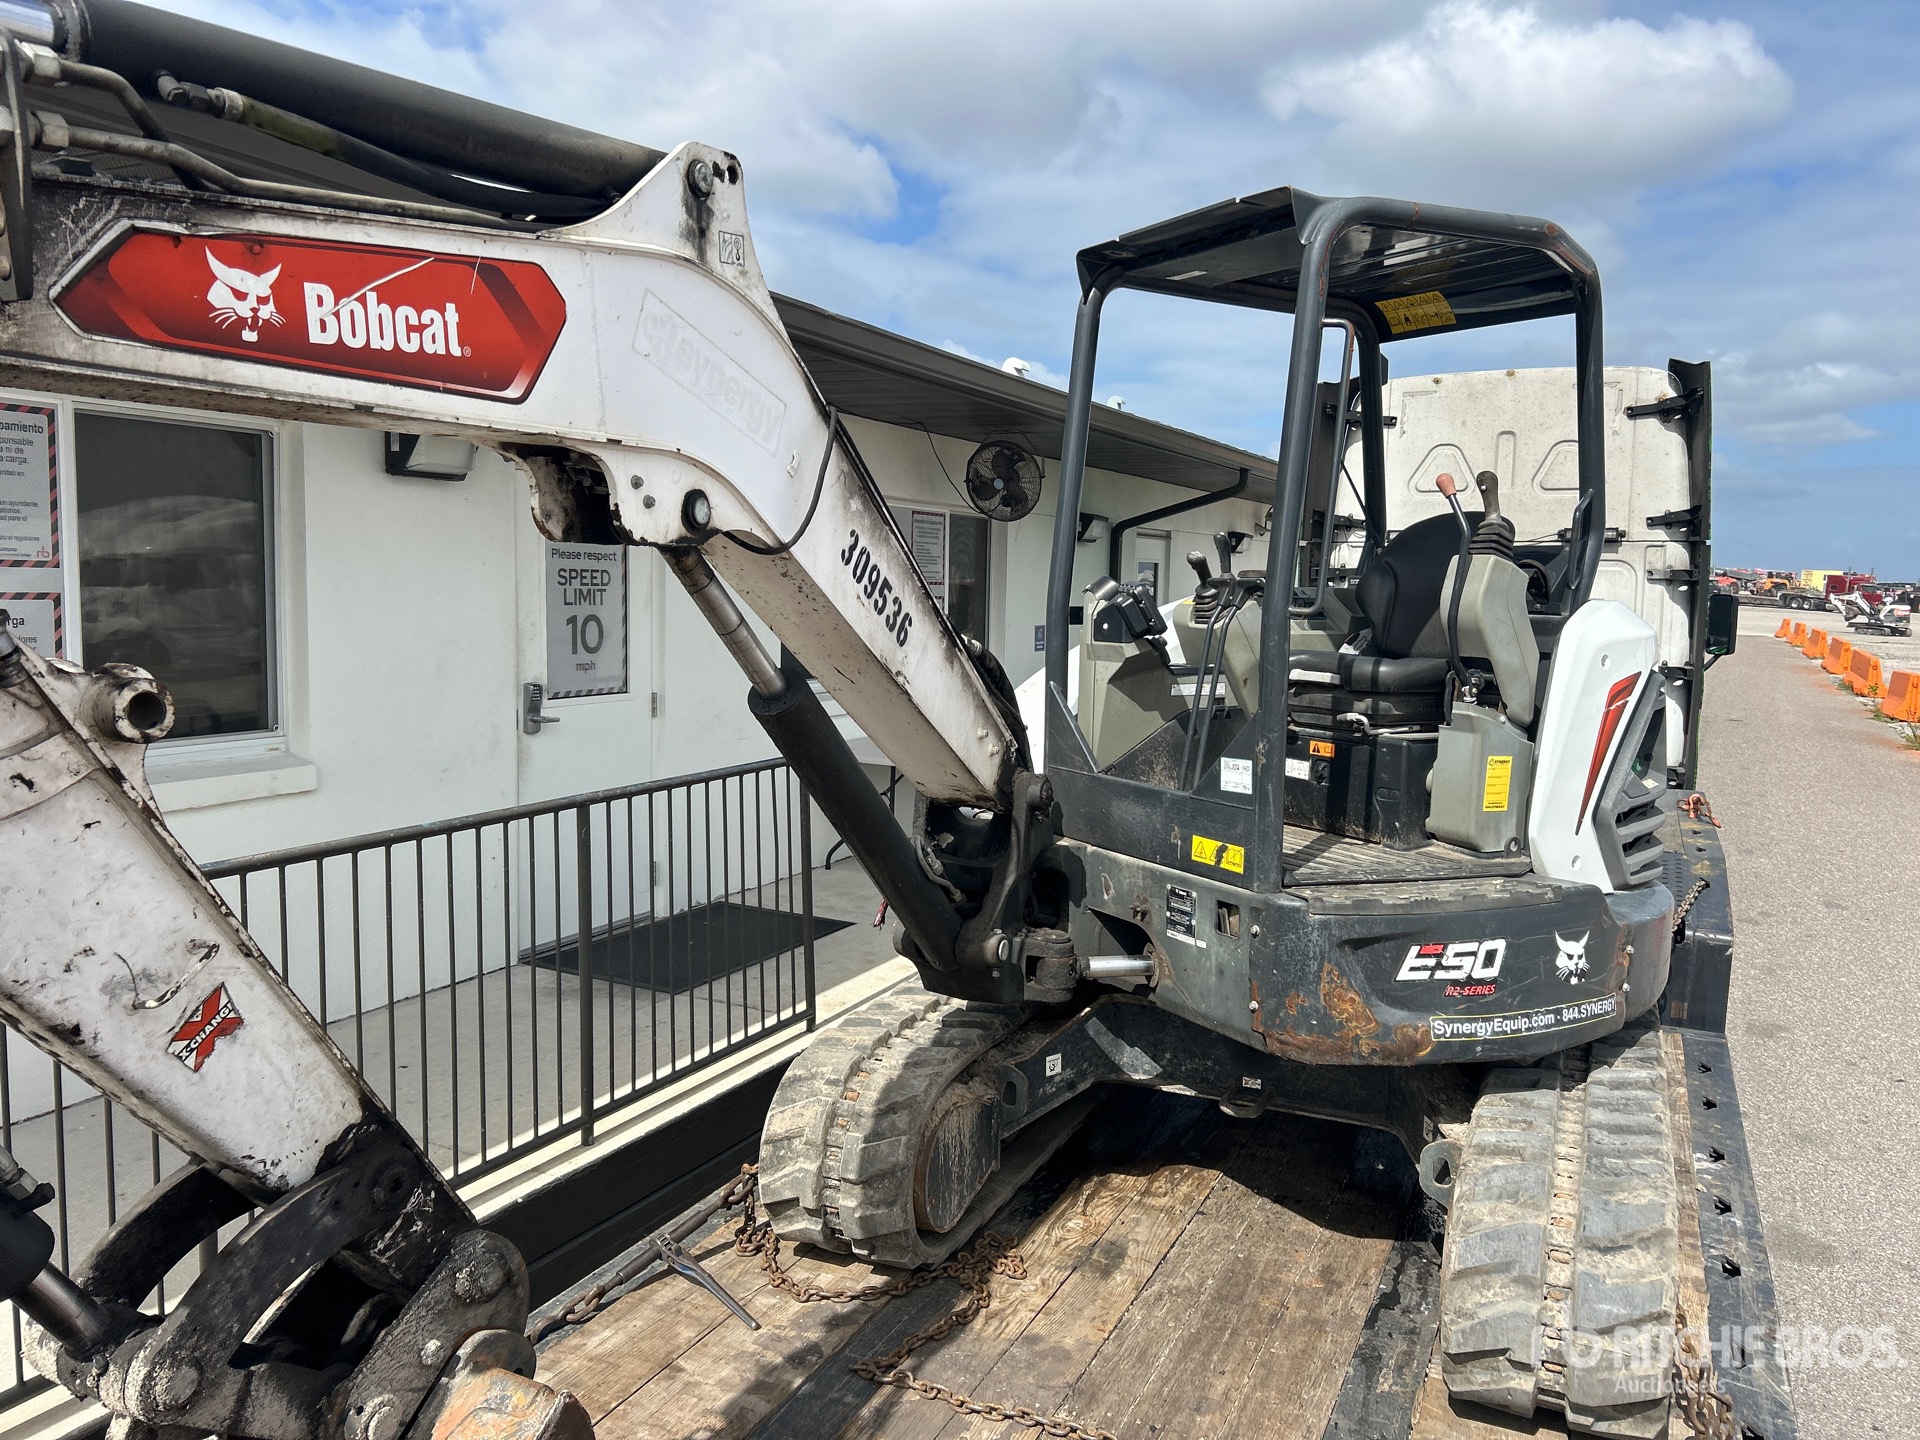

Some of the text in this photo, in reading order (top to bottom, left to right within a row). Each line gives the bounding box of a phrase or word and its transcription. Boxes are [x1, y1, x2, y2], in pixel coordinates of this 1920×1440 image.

[551, 548, 617, 563] Please respect
[557, 568, 612, 587] SPEED
[563, 588, 607, 606] LIMIT
[841, 529, 913, 647] 309536
[566, 613, 604, 655] 10
[576, 661, 596, 673] mph
[1395, 938, 1508, 982] E50
[1445, 984, 1496, 996] R2-SERIES
[1433, 1011, 1555, 1038] SynergyEquip.com
